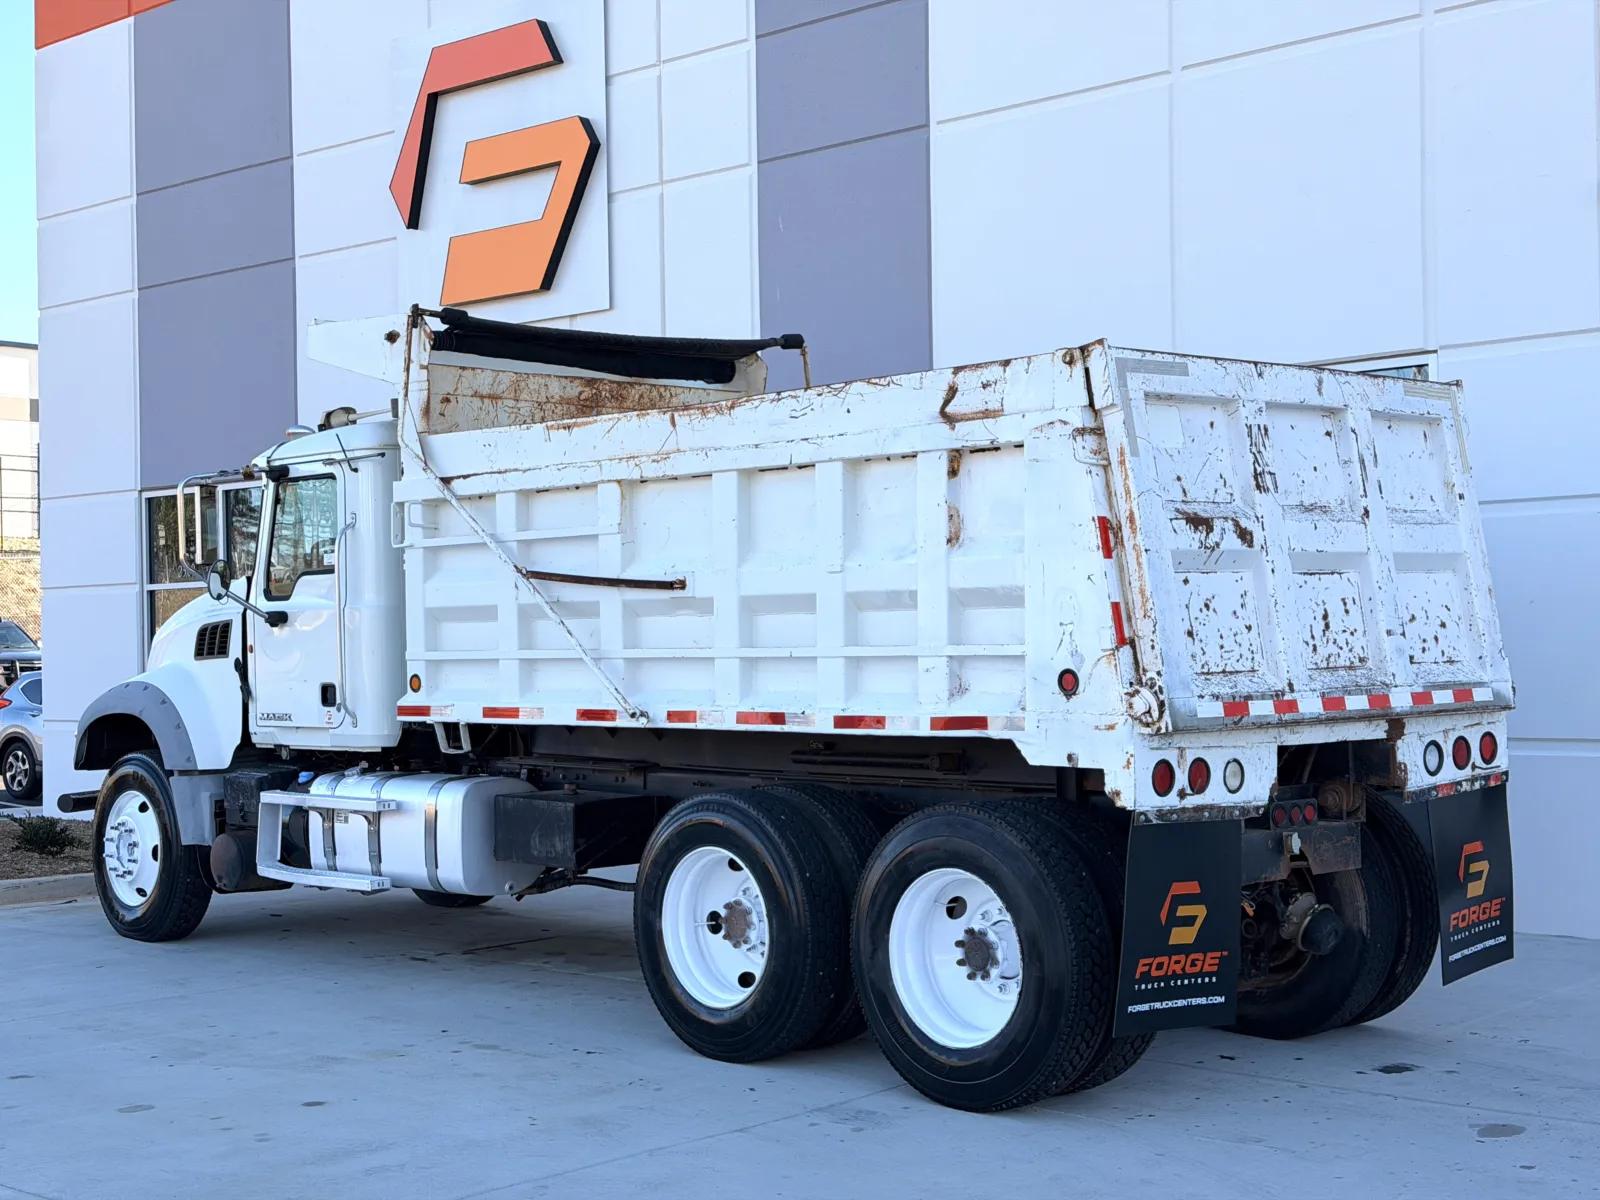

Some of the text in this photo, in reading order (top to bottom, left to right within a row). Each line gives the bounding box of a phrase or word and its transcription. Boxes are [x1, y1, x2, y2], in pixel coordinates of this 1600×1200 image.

[1449, 898, 1502, 932] FORGE
[1135, 952, 1221, 980] FORGE
[1134, 976, 1217, 991] TRUCK CENTERS
[1127, 995, 1225, 1013] FORGETRUCKCENTERS.COM
